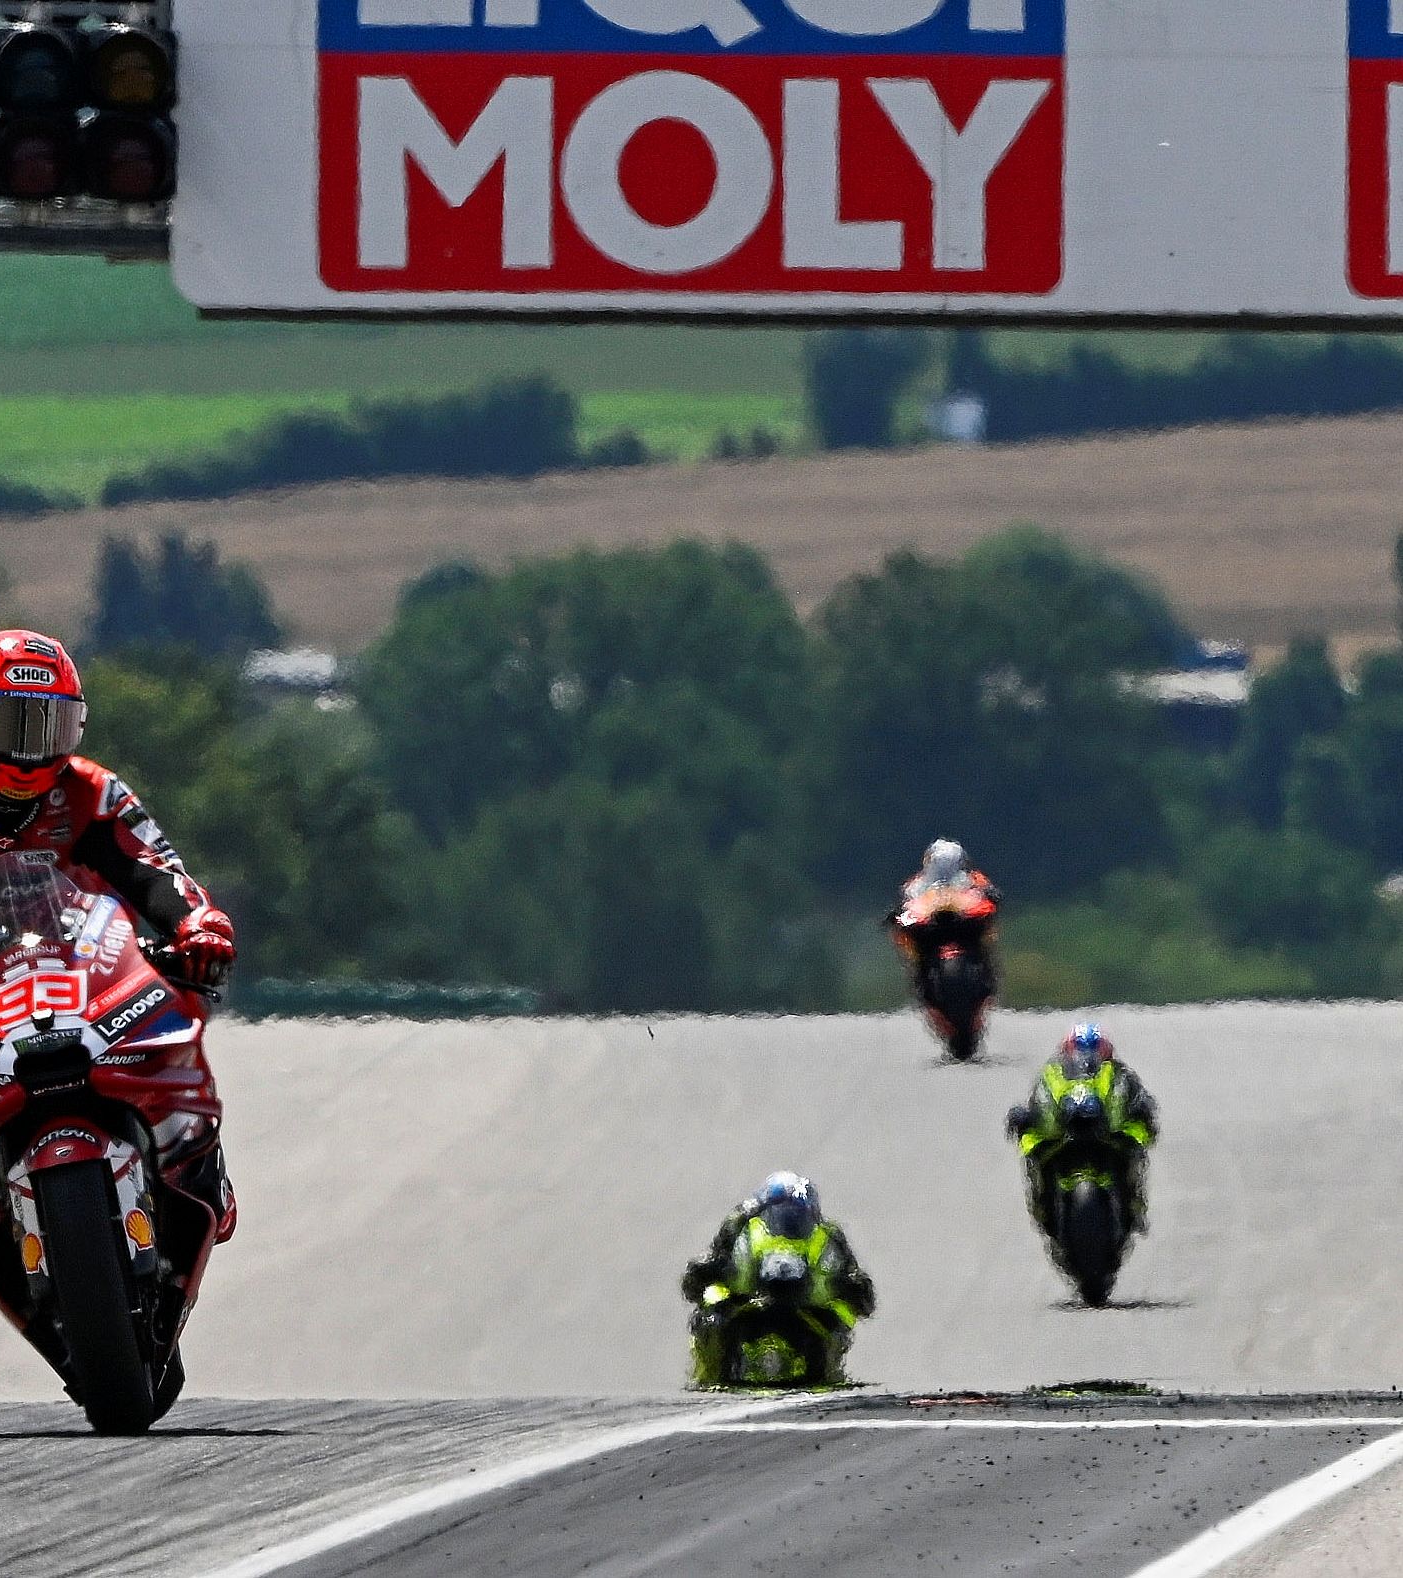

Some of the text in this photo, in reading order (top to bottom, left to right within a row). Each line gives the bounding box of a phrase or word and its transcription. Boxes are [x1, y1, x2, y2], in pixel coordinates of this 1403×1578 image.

[357, 69, 1053, 275] MOLY
[12, 667, 50, 683] SHOEI
[98, 987, 167, 1037] Lenovo
[95, 1053, 146, 1065] CARRERA
[30, 1128, 96, 1157] Lenovo
